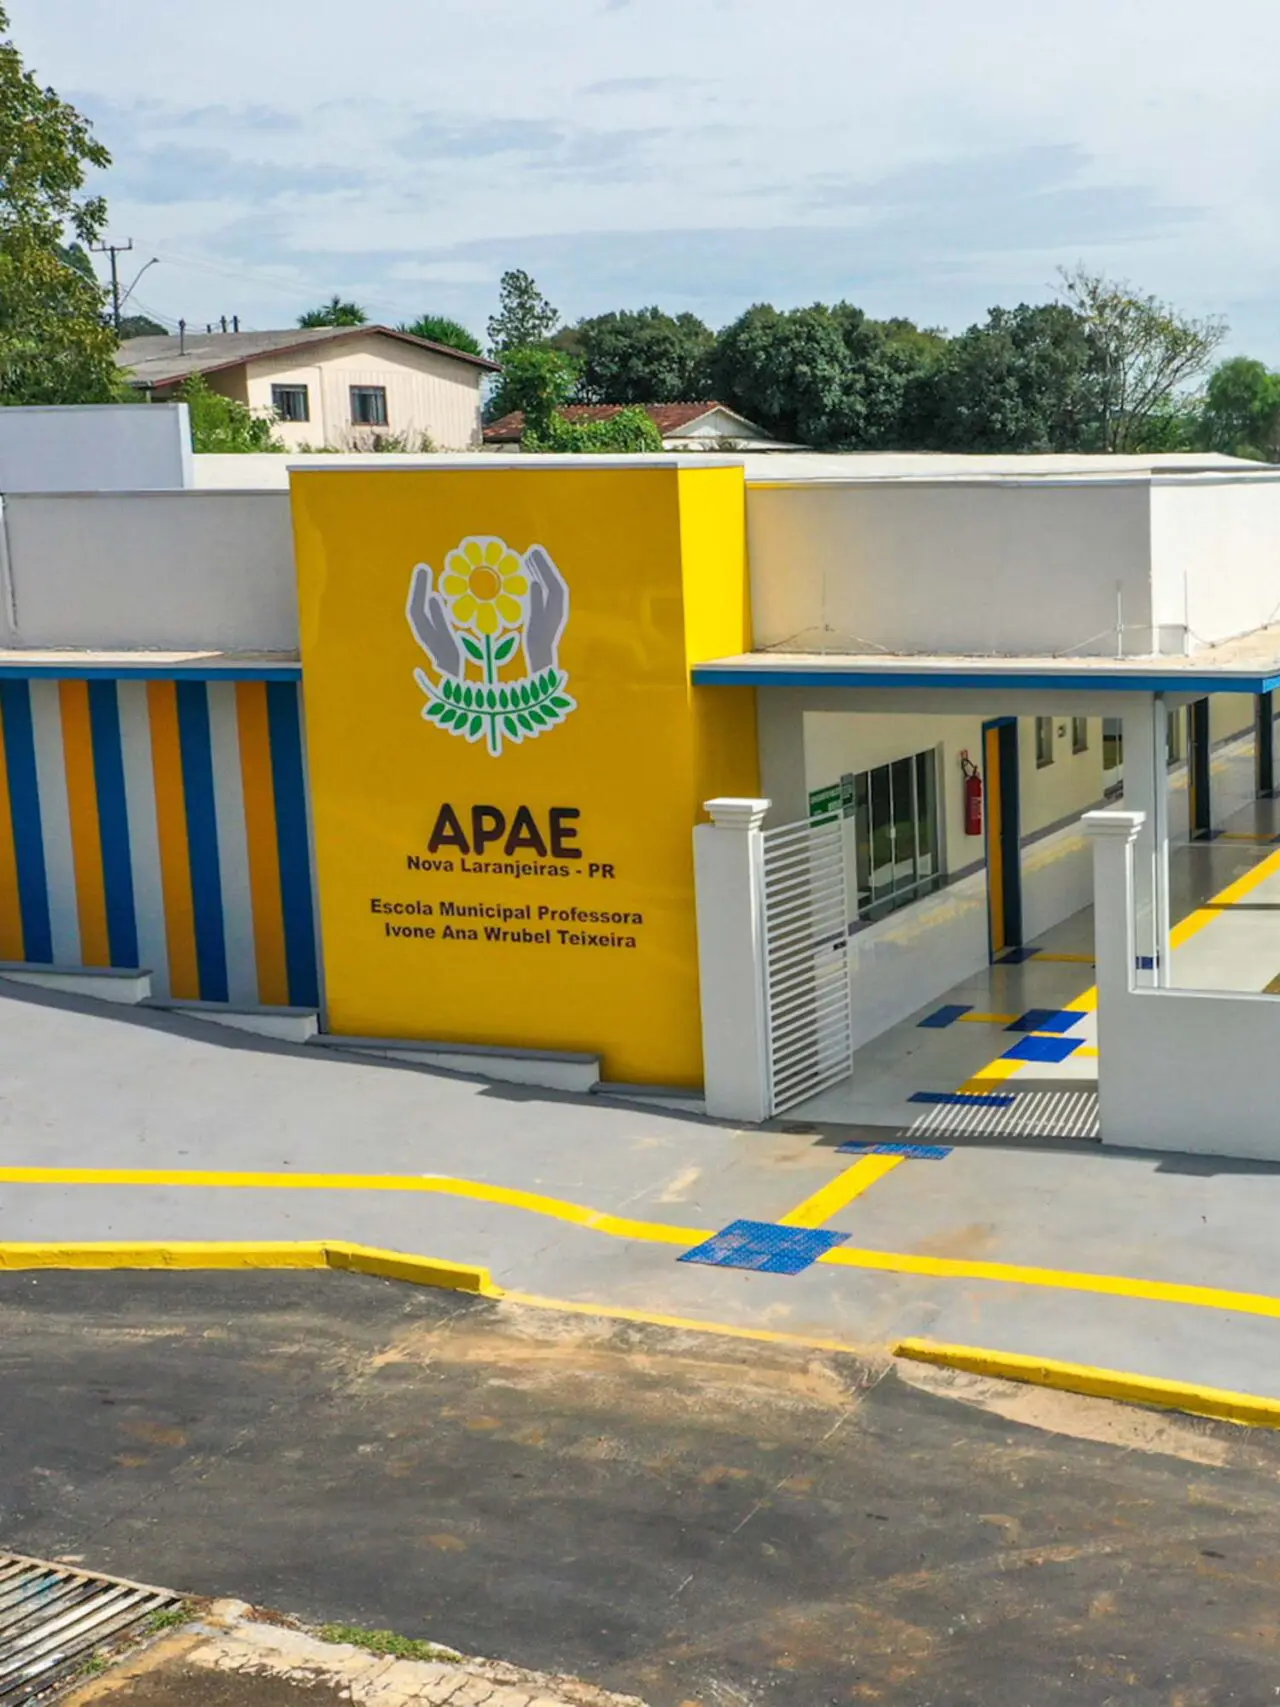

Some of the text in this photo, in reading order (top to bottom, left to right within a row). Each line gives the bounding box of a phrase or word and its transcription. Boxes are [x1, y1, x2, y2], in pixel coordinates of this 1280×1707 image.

[427, 803, 582, 859] APAE
[407, 856, 454, 873] Nova
[460, 858, 570, 879] Laranjeiras
[588, 863, 615, 878] PR
[370, 898, 643, 925] Escola Municipal Professora
[384, 922, 637, 949] Ivone Ana Wrubel Teixeira
